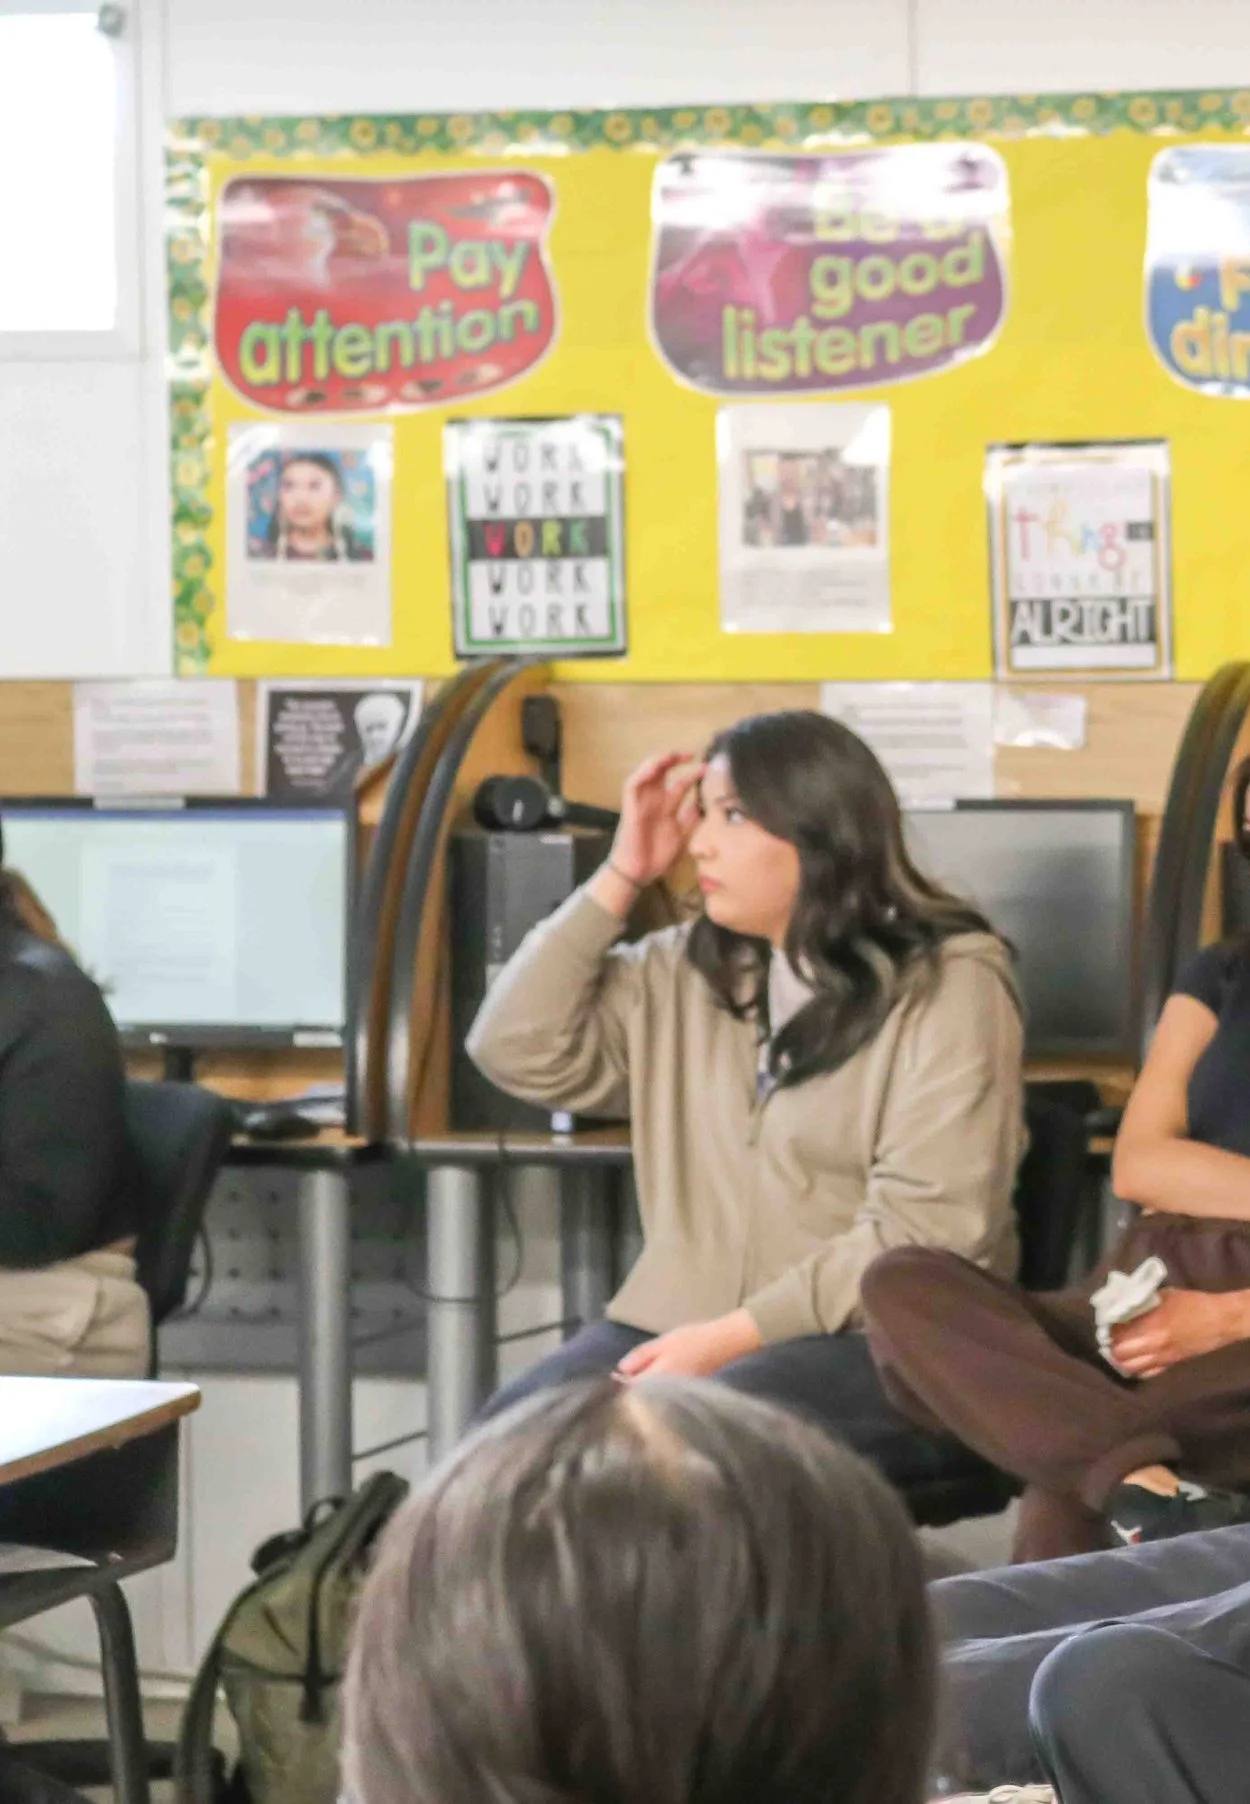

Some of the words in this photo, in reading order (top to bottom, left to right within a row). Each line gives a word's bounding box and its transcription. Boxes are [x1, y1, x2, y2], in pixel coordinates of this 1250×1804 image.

[408, 220, 530, 298] Pay
[810, 230, 985, 318] good
[239, 300, 540, 386] attention
[722, 303, 976, 380] listener
[484, 481, 587, 516] WORK
[485, 519, 590, 557] WORK
[489, 561, 591, 594] WORK
[490, 603, 591, 637] WORK
[1010, 599, 1153, 646] ALRIGHT
